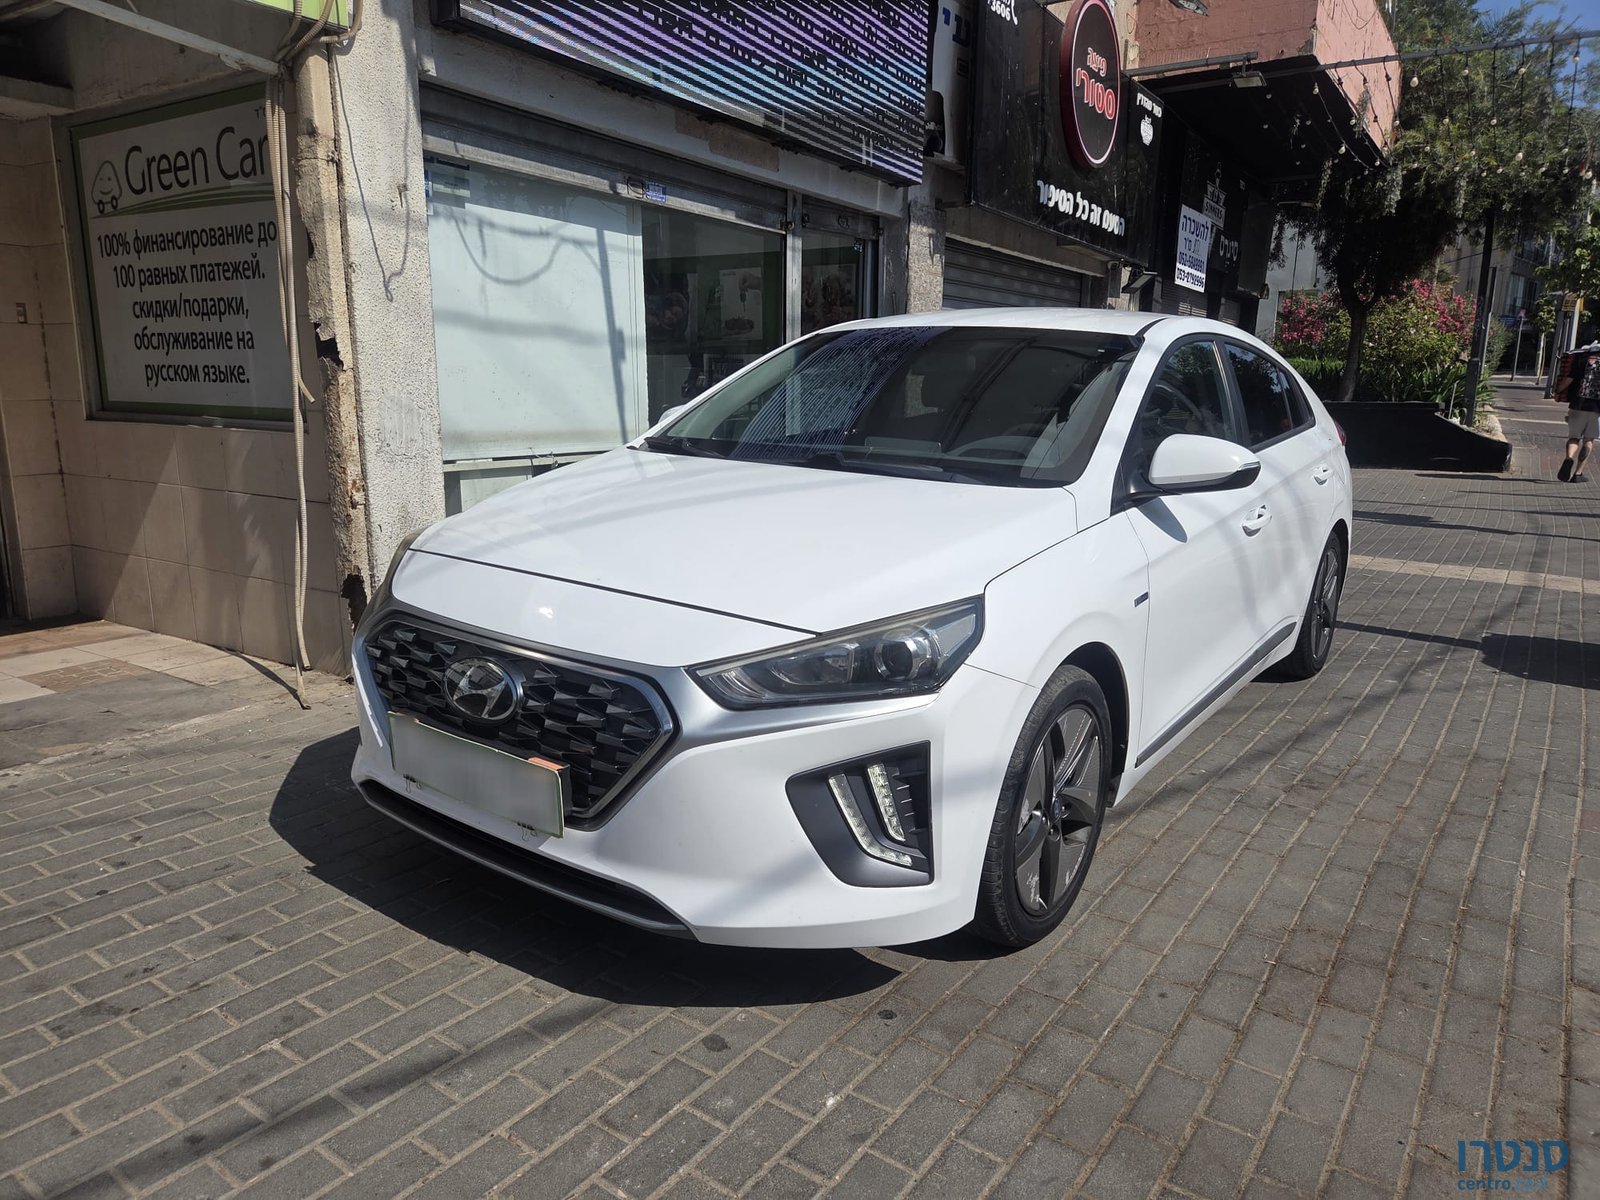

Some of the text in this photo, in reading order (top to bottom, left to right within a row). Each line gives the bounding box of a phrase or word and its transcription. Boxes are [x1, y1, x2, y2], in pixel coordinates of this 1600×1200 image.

[1075, 67, 1116, 120] סטורי
[125, 126, 268, 195] Green Car
[1037, 180, 1074, 216] הסיפור
[1075, 191, 1089, 221] כל
[1089, 203, 1102, 227] זה
[1181, 214, 1209, 242] להשכרה
[98, 220, 278, 260] 100% финансирование до
[113, 252, 265, 292] 100 равных платежей.
[132, 292, 249, 323] скидки/подарки,
[134, 325, 255, 357] обслуживание на
[144, 363, 250, 388] русском языке.
